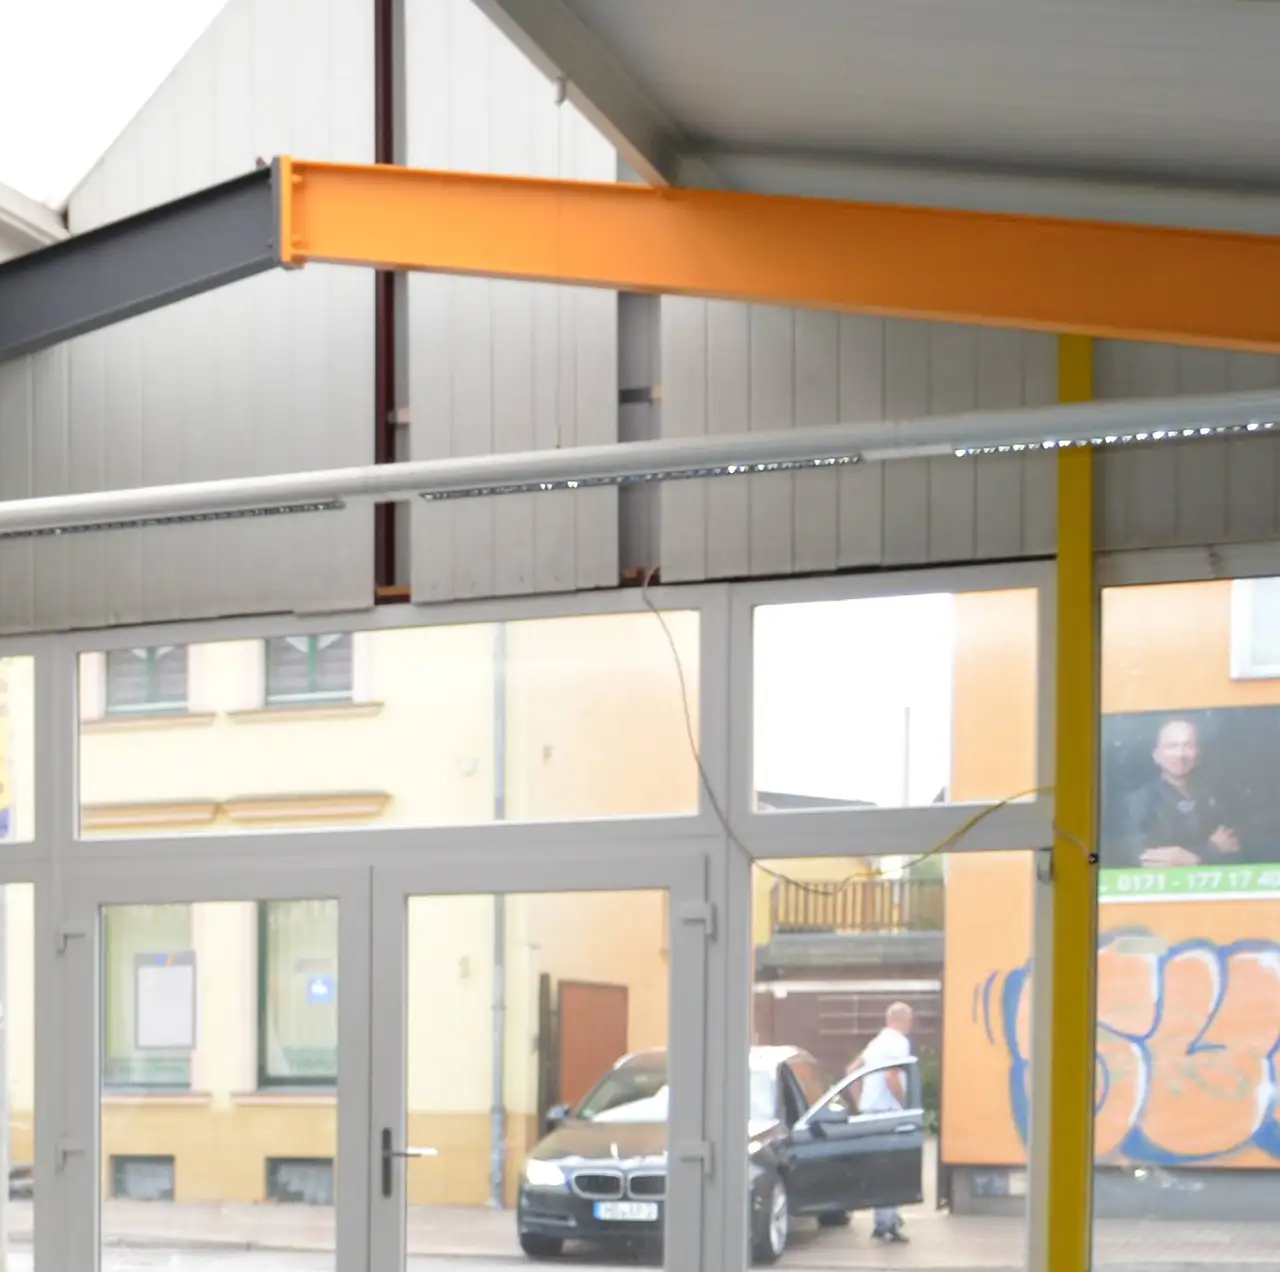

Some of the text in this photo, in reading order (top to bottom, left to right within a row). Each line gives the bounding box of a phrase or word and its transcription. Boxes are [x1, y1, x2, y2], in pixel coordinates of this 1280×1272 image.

[1117, 872, 1167, 891] 0171
[1188, 871, 1223, 889] 177
[1228, 870, 1252, 889] 17
